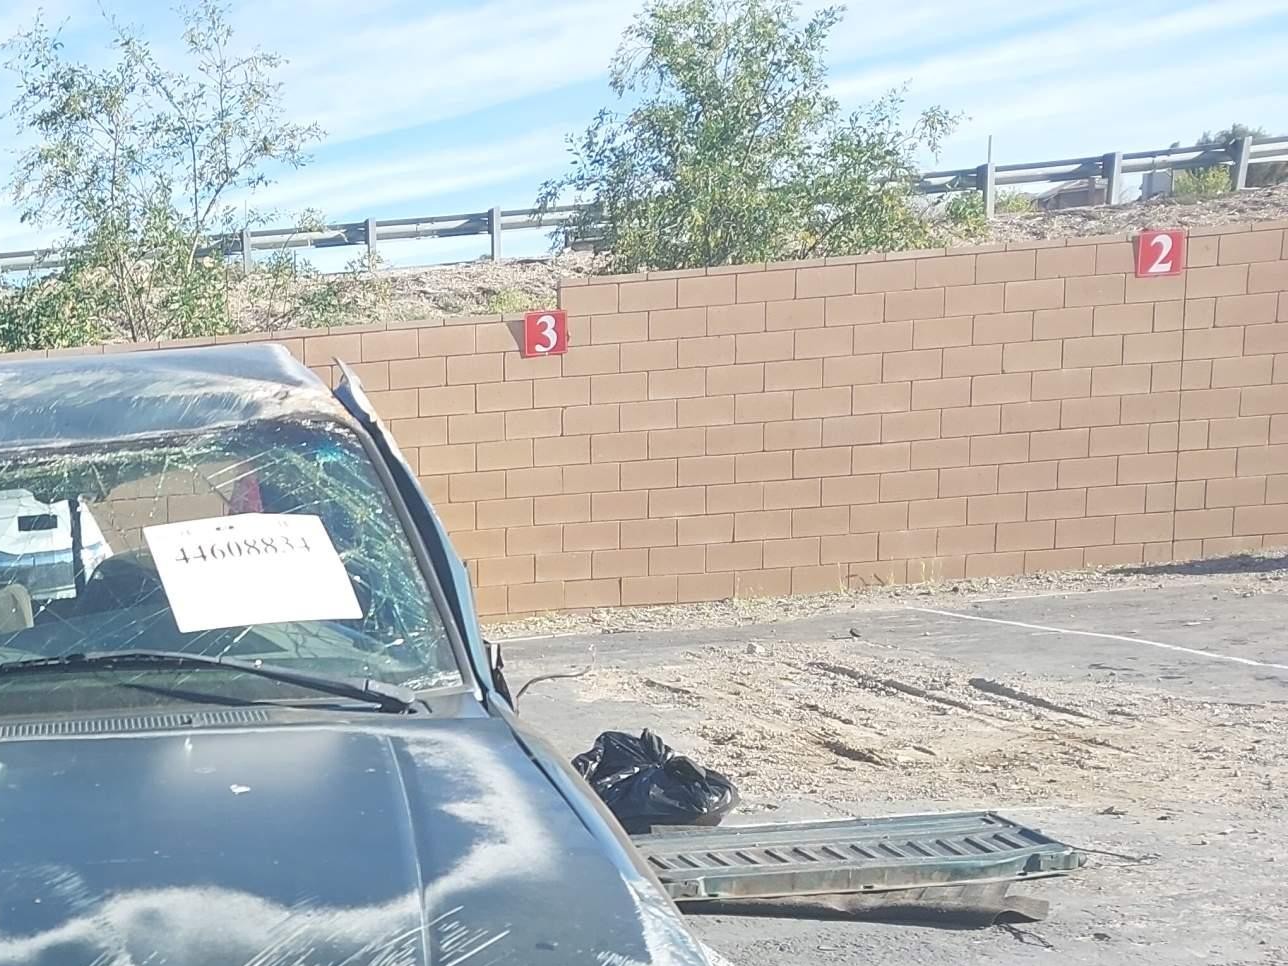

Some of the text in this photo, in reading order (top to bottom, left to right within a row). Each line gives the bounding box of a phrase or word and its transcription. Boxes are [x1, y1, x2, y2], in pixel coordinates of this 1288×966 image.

[1147, 234, 1172, 273] 2
[534, 315, 558, 353] 3
[175, 536, 311, 564] 44608834
